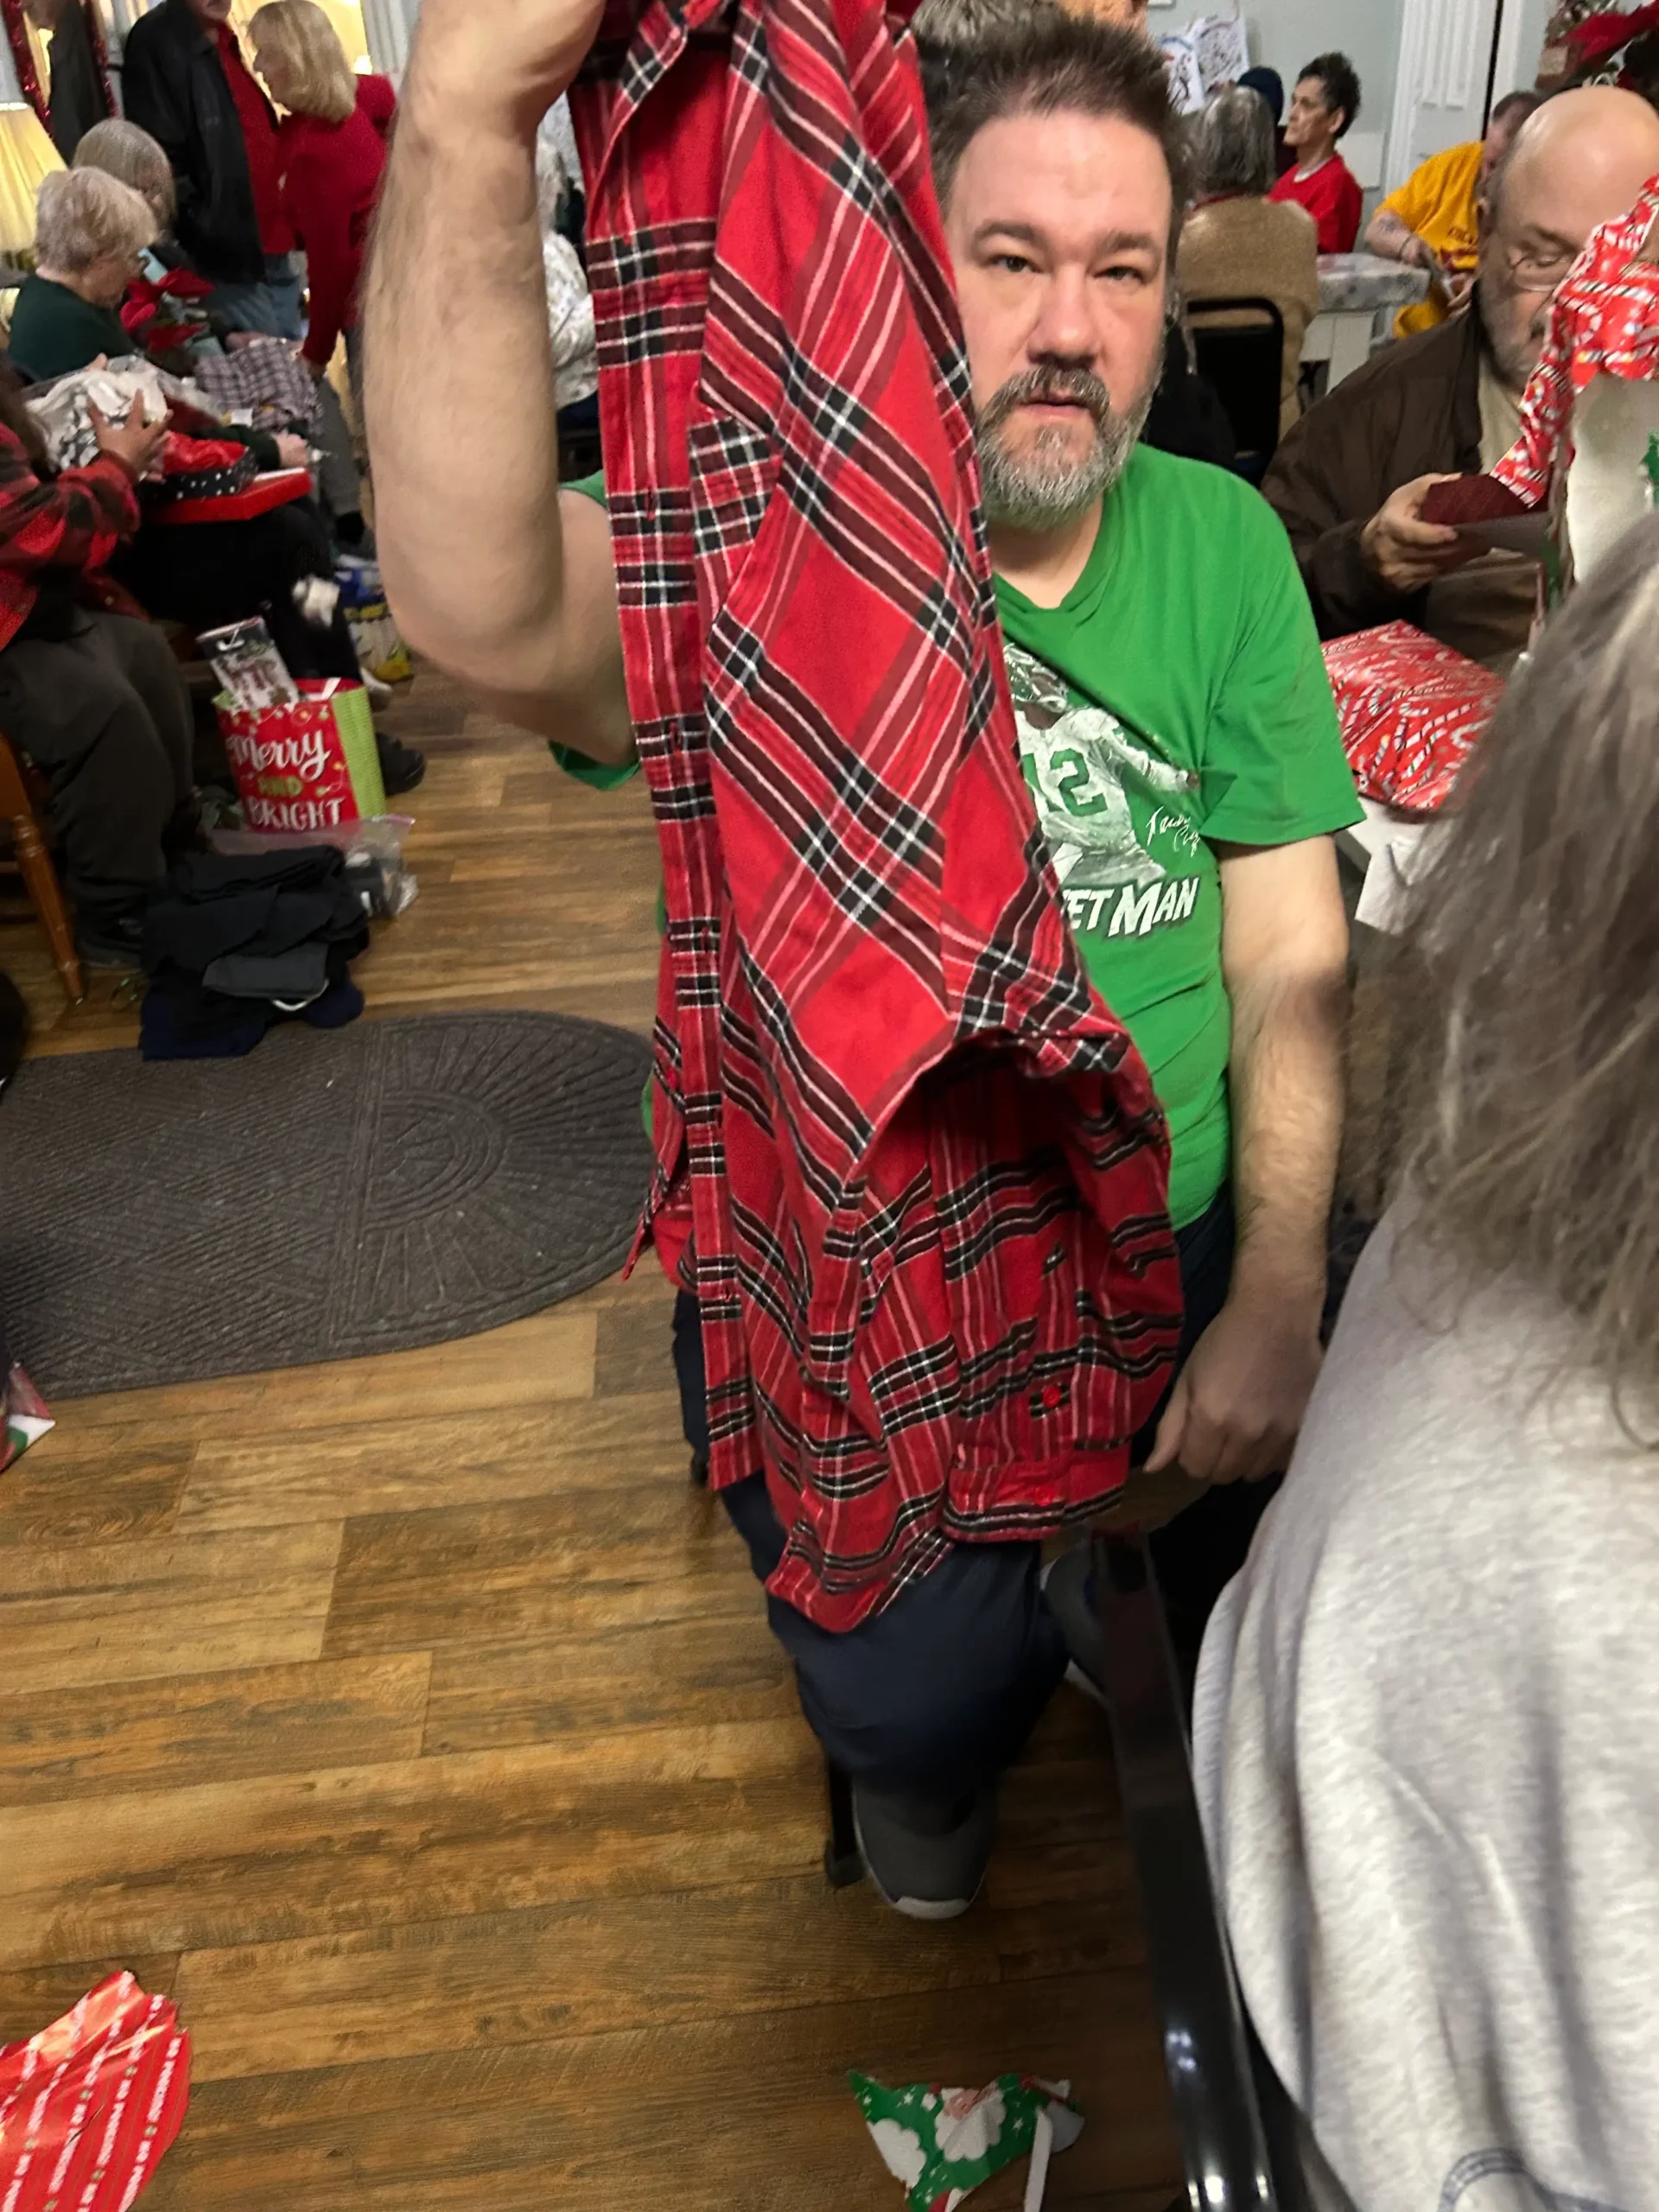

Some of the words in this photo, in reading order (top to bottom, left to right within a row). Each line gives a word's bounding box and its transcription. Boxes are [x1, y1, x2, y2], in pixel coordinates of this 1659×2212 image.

[226, 729, 332, 782] Merry
[245, 796, 346, 830] BRIGHT
[1108, 877, 1199, 938] MAN
